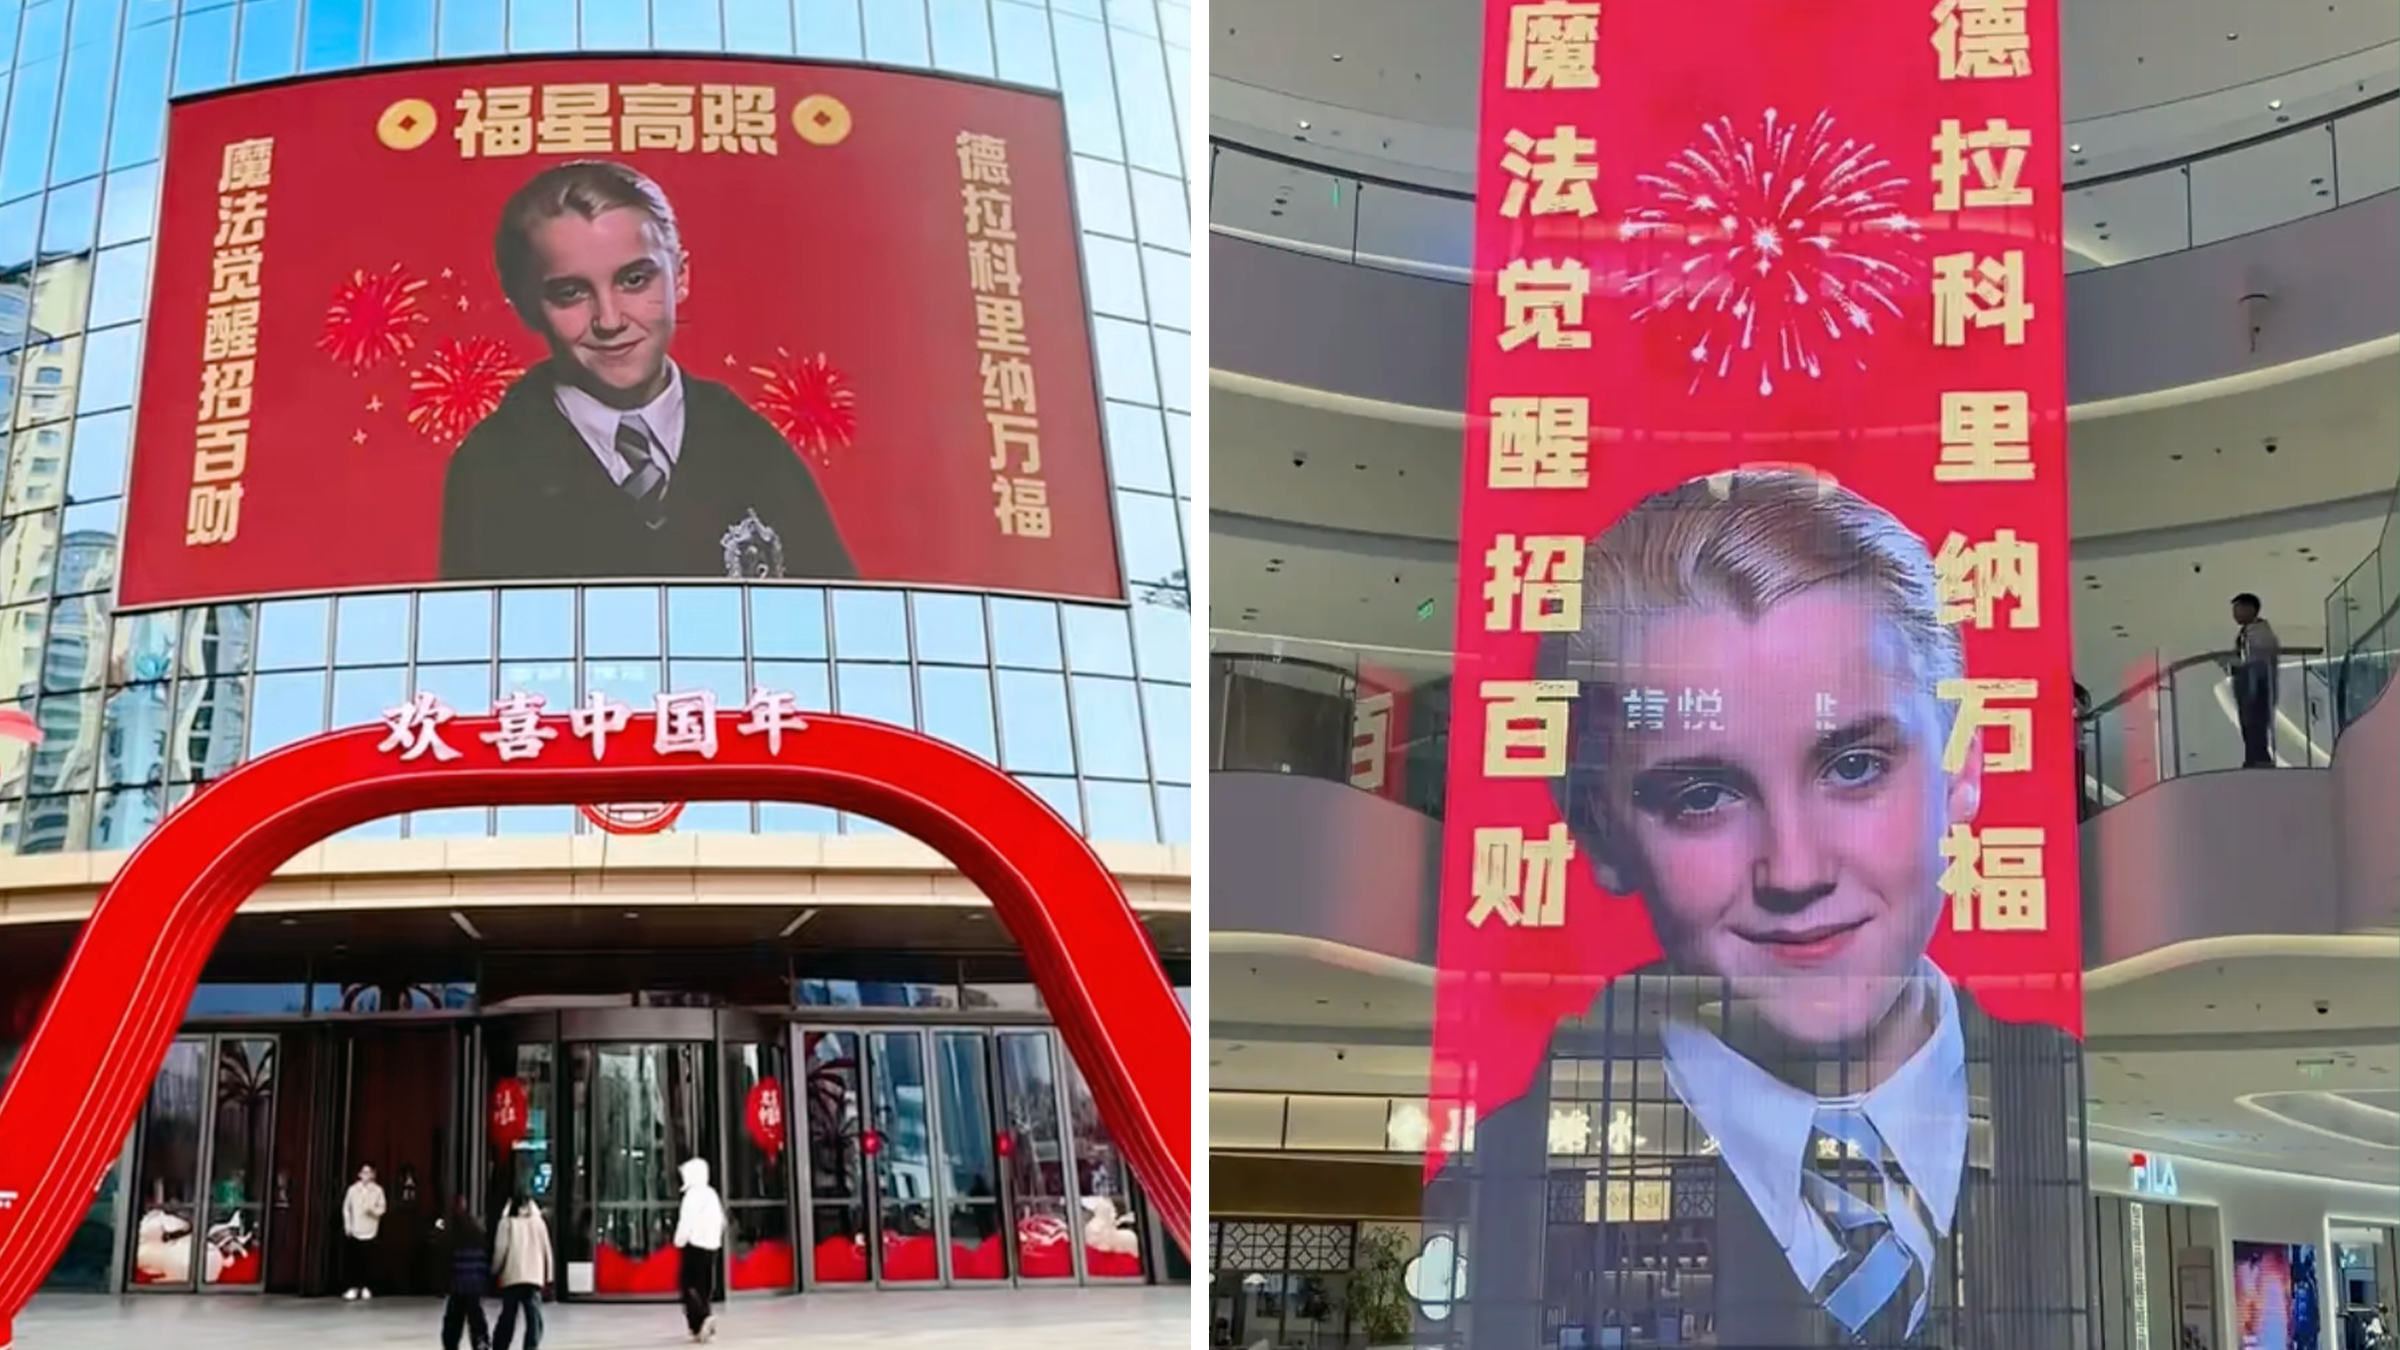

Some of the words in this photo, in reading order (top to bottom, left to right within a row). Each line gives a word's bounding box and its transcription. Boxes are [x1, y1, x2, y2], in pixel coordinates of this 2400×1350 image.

[454, 82, 778, 158] 福星高照
[185, 136, 274, 546] 魔法觉醒招百财
[955, 129, 1052, 539] 德拉科里纳万福
[1467, 0, 1601, 928] 魔法觉醒招百财
[1930, 0, 2047, 932] 德拉科里纳万福
[377, 687, 810, 761] 欢喜中国年
[2130, 1151, 2179, 1197] FILA
